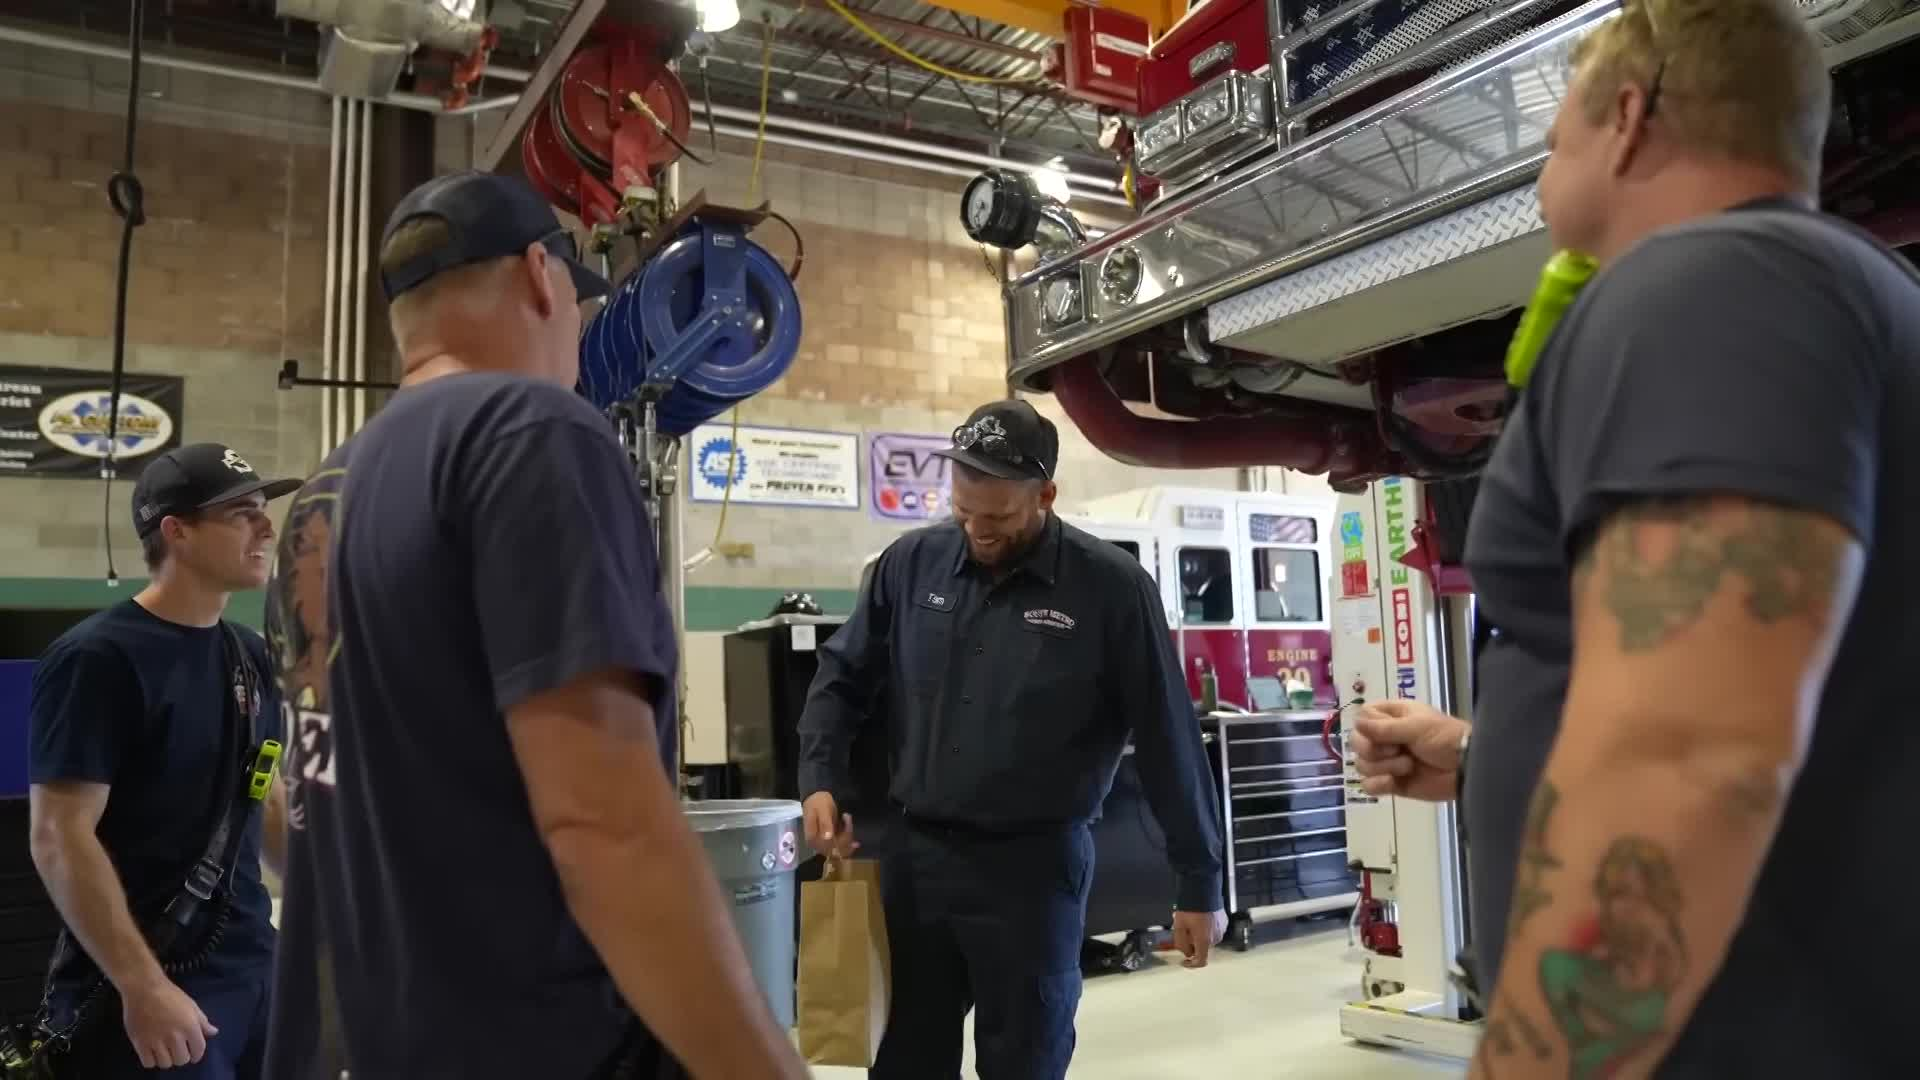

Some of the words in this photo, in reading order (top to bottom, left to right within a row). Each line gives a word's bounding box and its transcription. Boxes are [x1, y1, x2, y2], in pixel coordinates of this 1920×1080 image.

[884, 449, 950, 479] EVT
[1394, 591, 1410, 661] KONI
[1266, 648, 1319, 662] ENGINE
